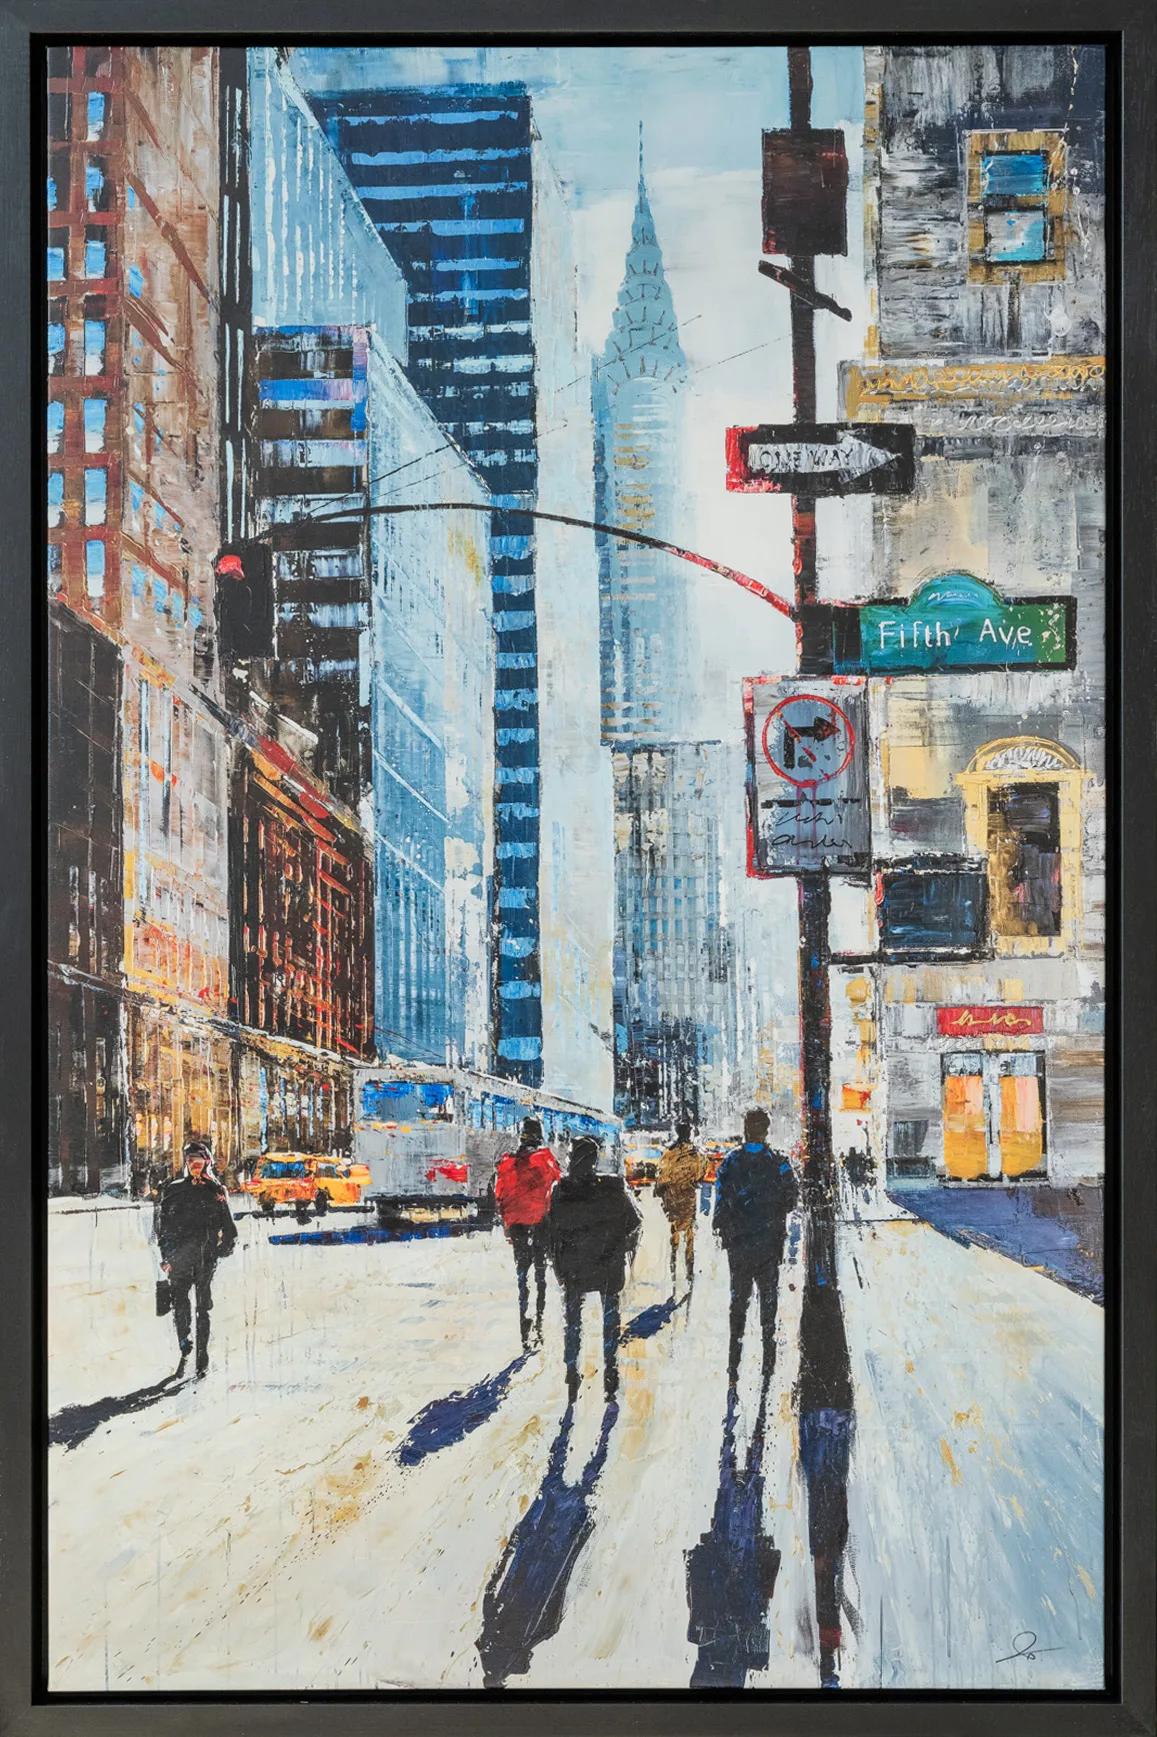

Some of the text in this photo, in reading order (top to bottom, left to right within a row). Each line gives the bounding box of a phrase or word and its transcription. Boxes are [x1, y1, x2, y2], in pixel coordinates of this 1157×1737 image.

[760, 447, 854, 470] ONE WAY
[878, 620, 952, 649] Fifth
